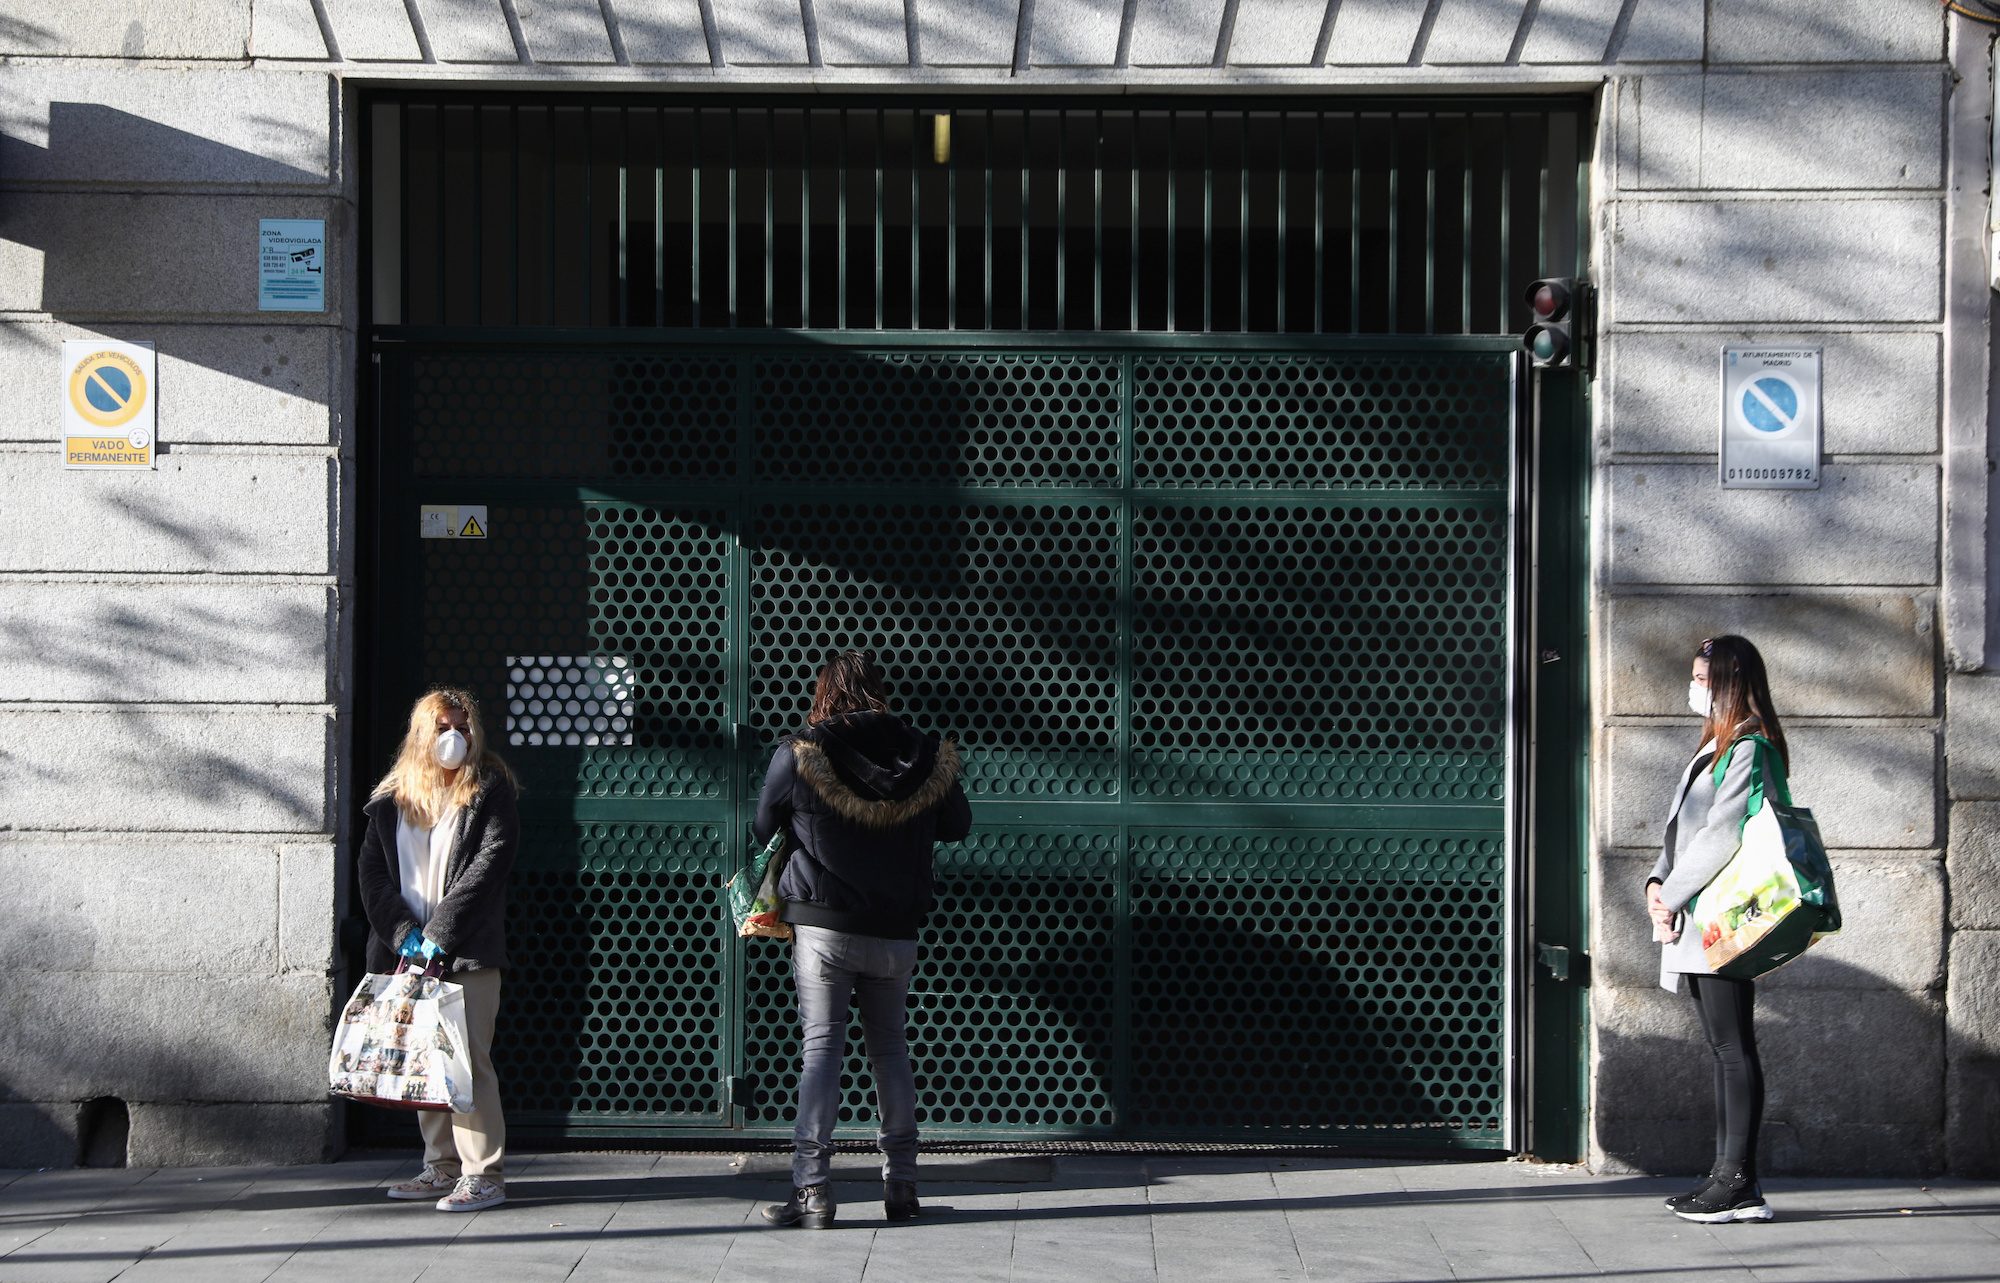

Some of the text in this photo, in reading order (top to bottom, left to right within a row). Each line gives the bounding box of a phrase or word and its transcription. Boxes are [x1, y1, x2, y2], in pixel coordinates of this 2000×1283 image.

[75, 356, 96, 375] SALIDA
[92, 441, 125, 450] VADO
[70, 453, 146, 462] PERMANENTE
